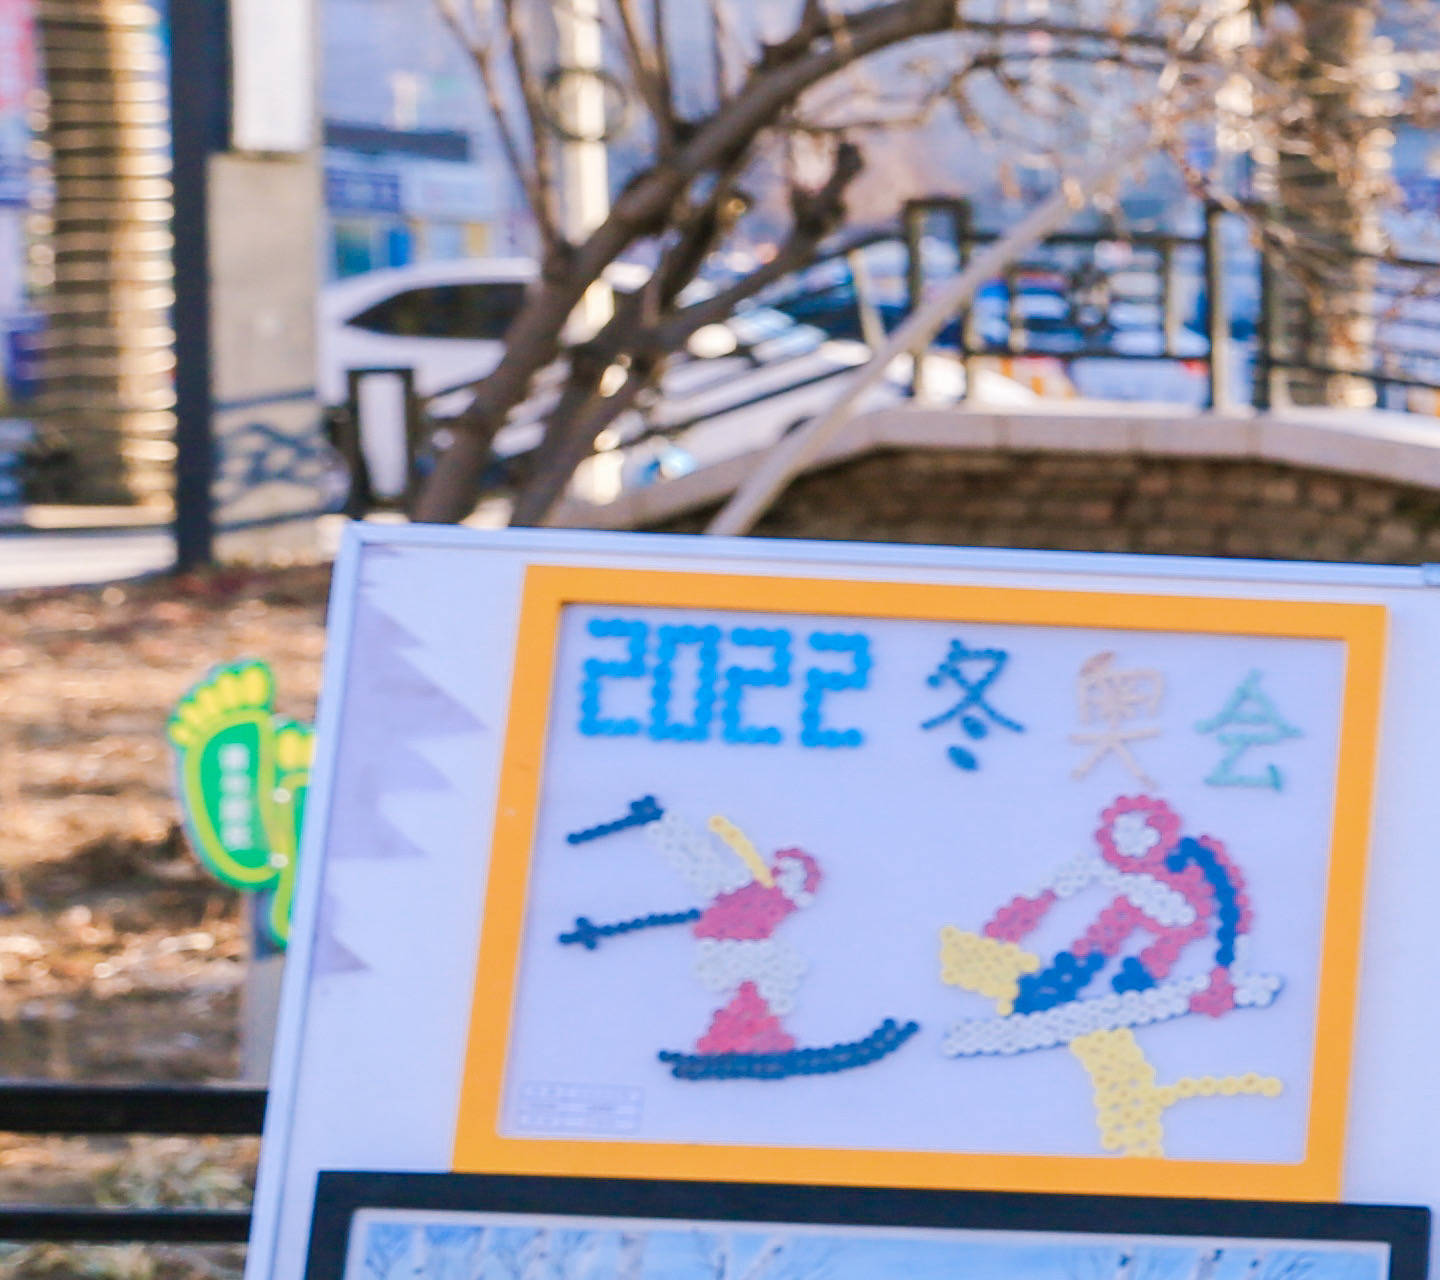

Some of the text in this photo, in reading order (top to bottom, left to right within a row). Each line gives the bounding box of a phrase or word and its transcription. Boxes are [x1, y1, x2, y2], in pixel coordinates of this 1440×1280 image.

[577, 617, 1304, 794] 2022 冬奥会
